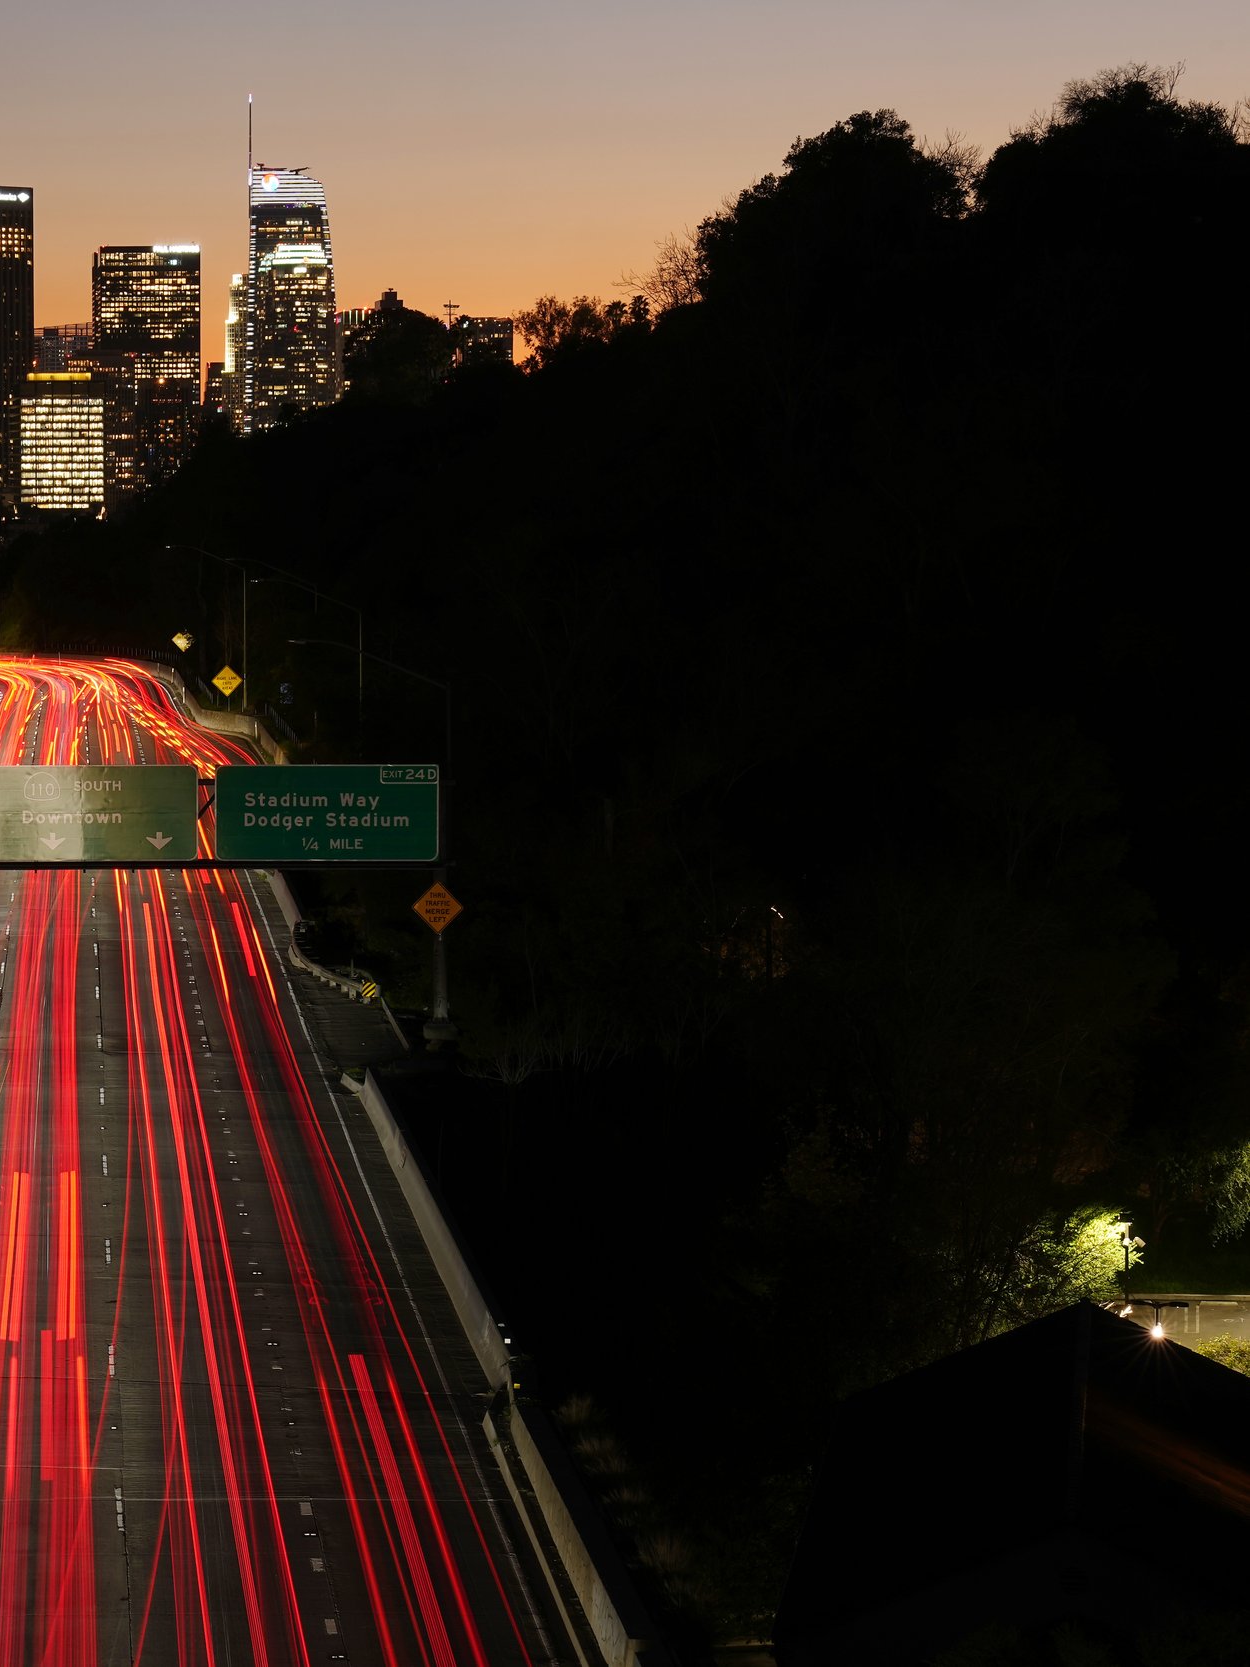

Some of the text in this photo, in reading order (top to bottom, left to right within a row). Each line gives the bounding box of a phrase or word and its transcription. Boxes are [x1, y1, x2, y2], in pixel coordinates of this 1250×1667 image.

[382, 770, 403, 778] EXIT
[30, 780, 122, 797] 110 SOUTH
[244, 792, 380, 810] Stadium Way
[22, 810, 122, 825] Downtown
[243, 812, 410, 831] Dodger Stadium
[329, 838, 364, 850] MILE
